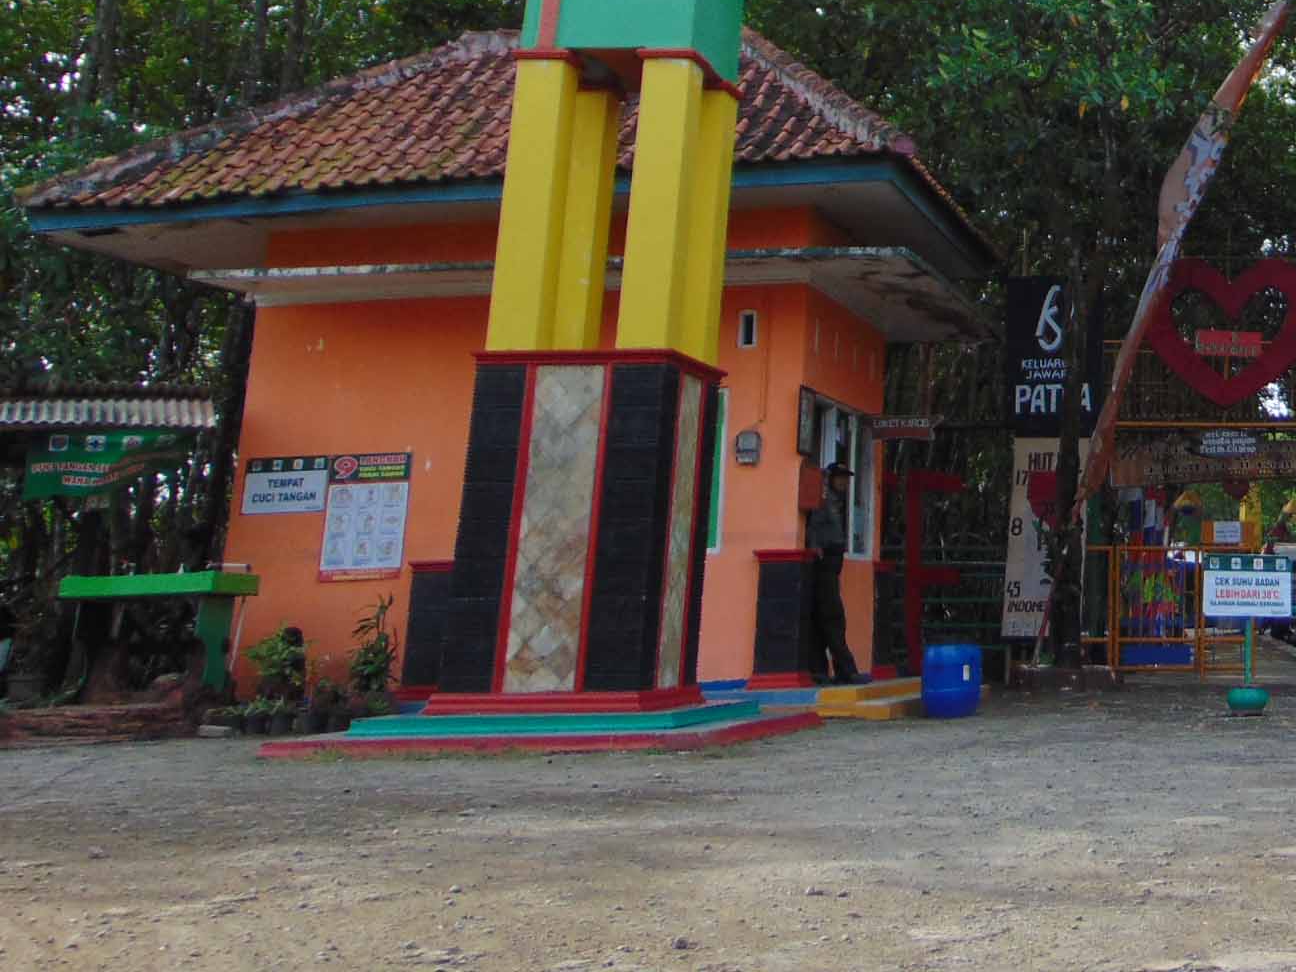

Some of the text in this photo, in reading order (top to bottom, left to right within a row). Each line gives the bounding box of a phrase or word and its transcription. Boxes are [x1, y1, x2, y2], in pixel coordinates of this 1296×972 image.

[1022, 358, 1065, 369] KELUAR
[1015, 383, 1092, 413] PATA
[334, 456, 359, 479] 9
[267, 477, 305, 489] TEMPAT
[252, 491, 317, 503] CUCI TANGAN
[1011, 517, 1023, 536] 8
[1255, 577, 1280, 586] BADAN
[1007, 600, 1045, 613] INDONE
